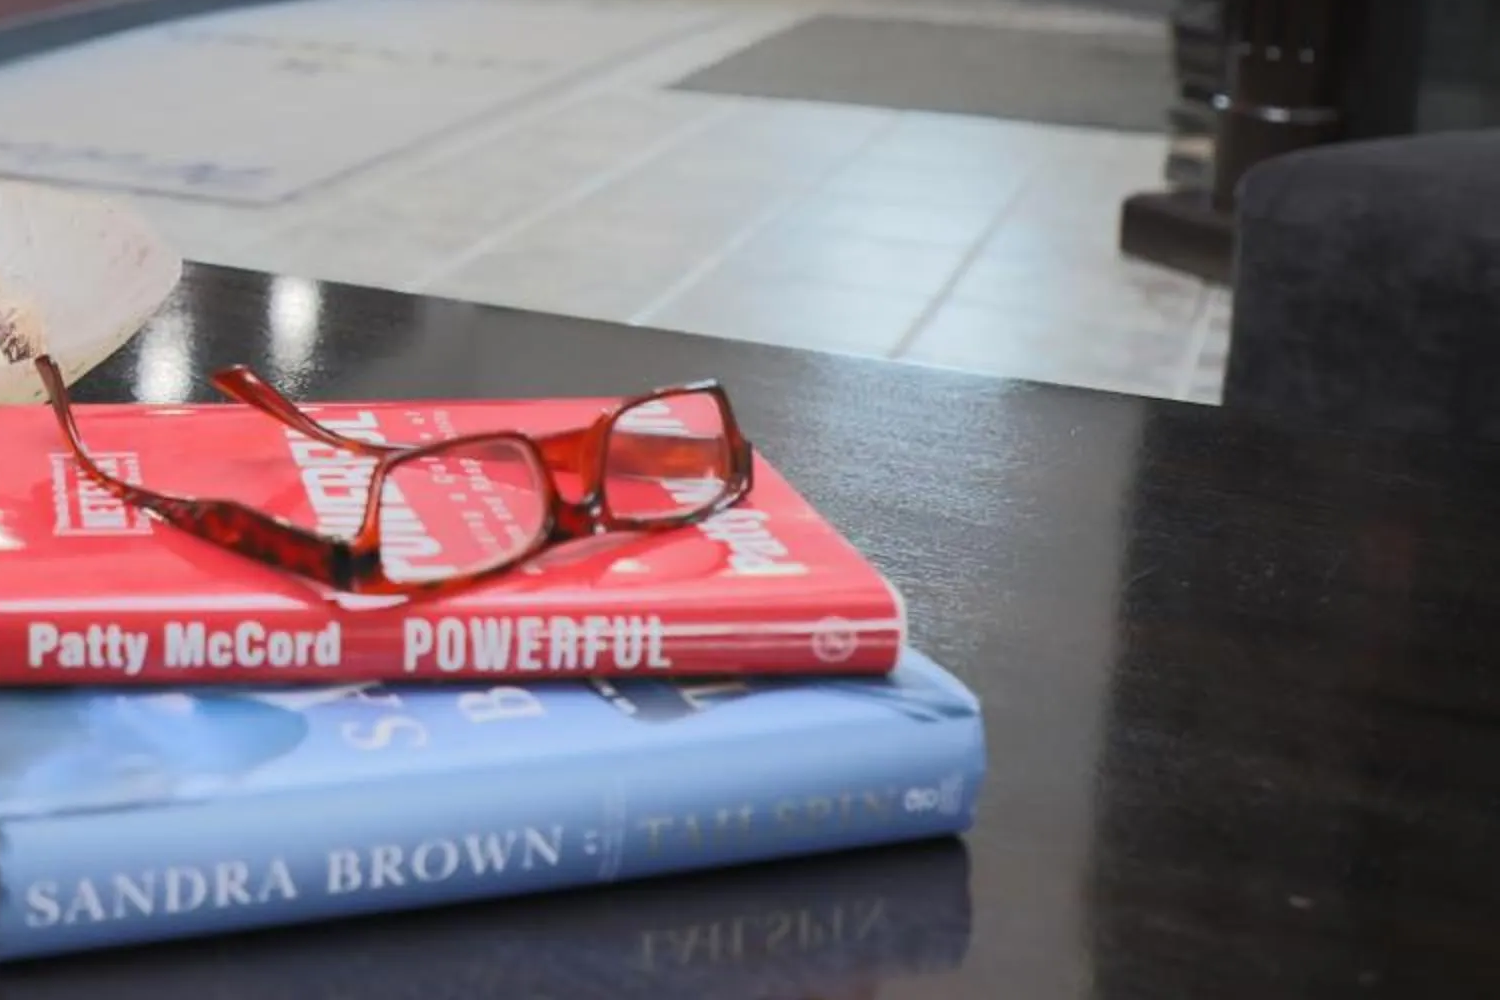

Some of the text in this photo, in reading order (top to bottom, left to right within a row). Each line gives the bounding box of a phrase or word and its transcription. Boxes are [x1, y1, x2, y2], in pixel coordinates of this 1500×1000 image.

[27, 616, 672, 675] Patty McCord POWERFUL
[26, 856, 298, 929] SANDRA
[325, 824, 564, 896] BROWN
